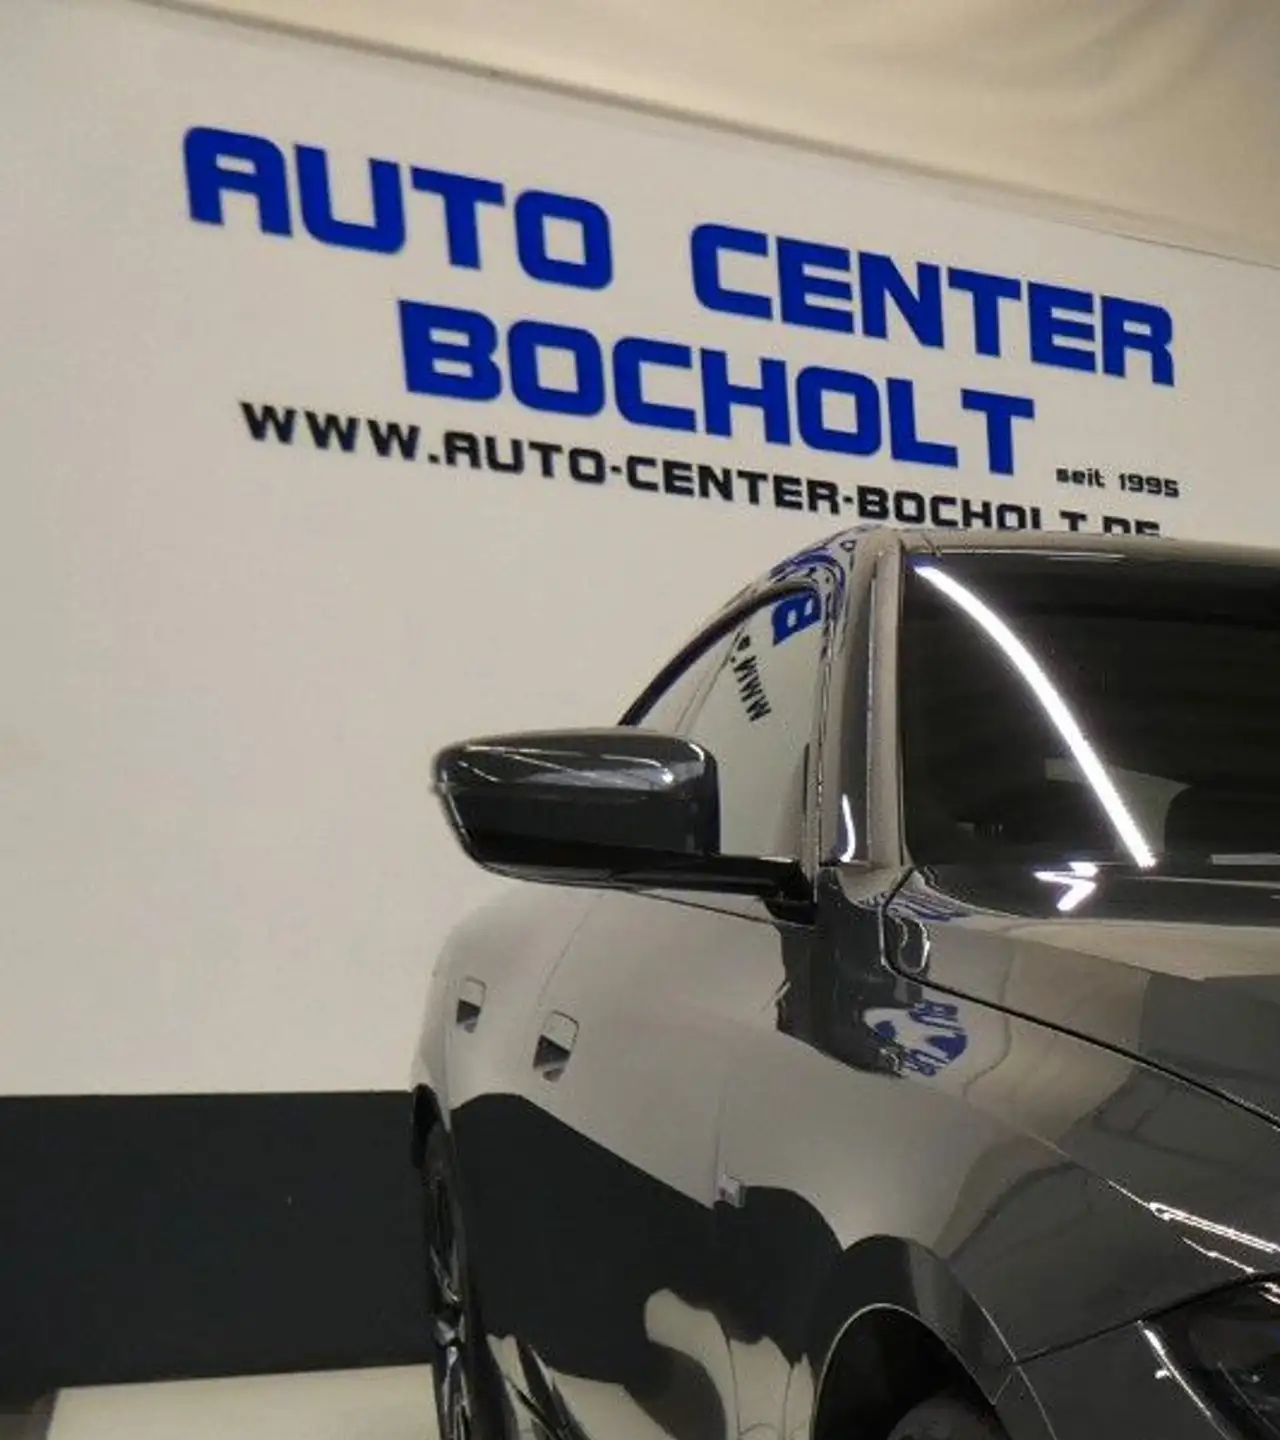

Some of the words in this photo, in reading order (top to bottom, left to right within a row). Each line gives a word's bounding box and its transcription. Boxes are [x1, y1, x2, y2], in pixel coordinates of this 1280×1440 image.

[183, 126, 614, 291] AUTO
[690, 222, 1175, 387] CENTER
[240, 401, 1161, 538] WWW.AUTO-CENTER-BOCHOLTDE
[398, 299, 1036, 477] BOCHOLT
[1056, 468, 1105, 488] seit
[1118, 473, 1180, 498] 1995
